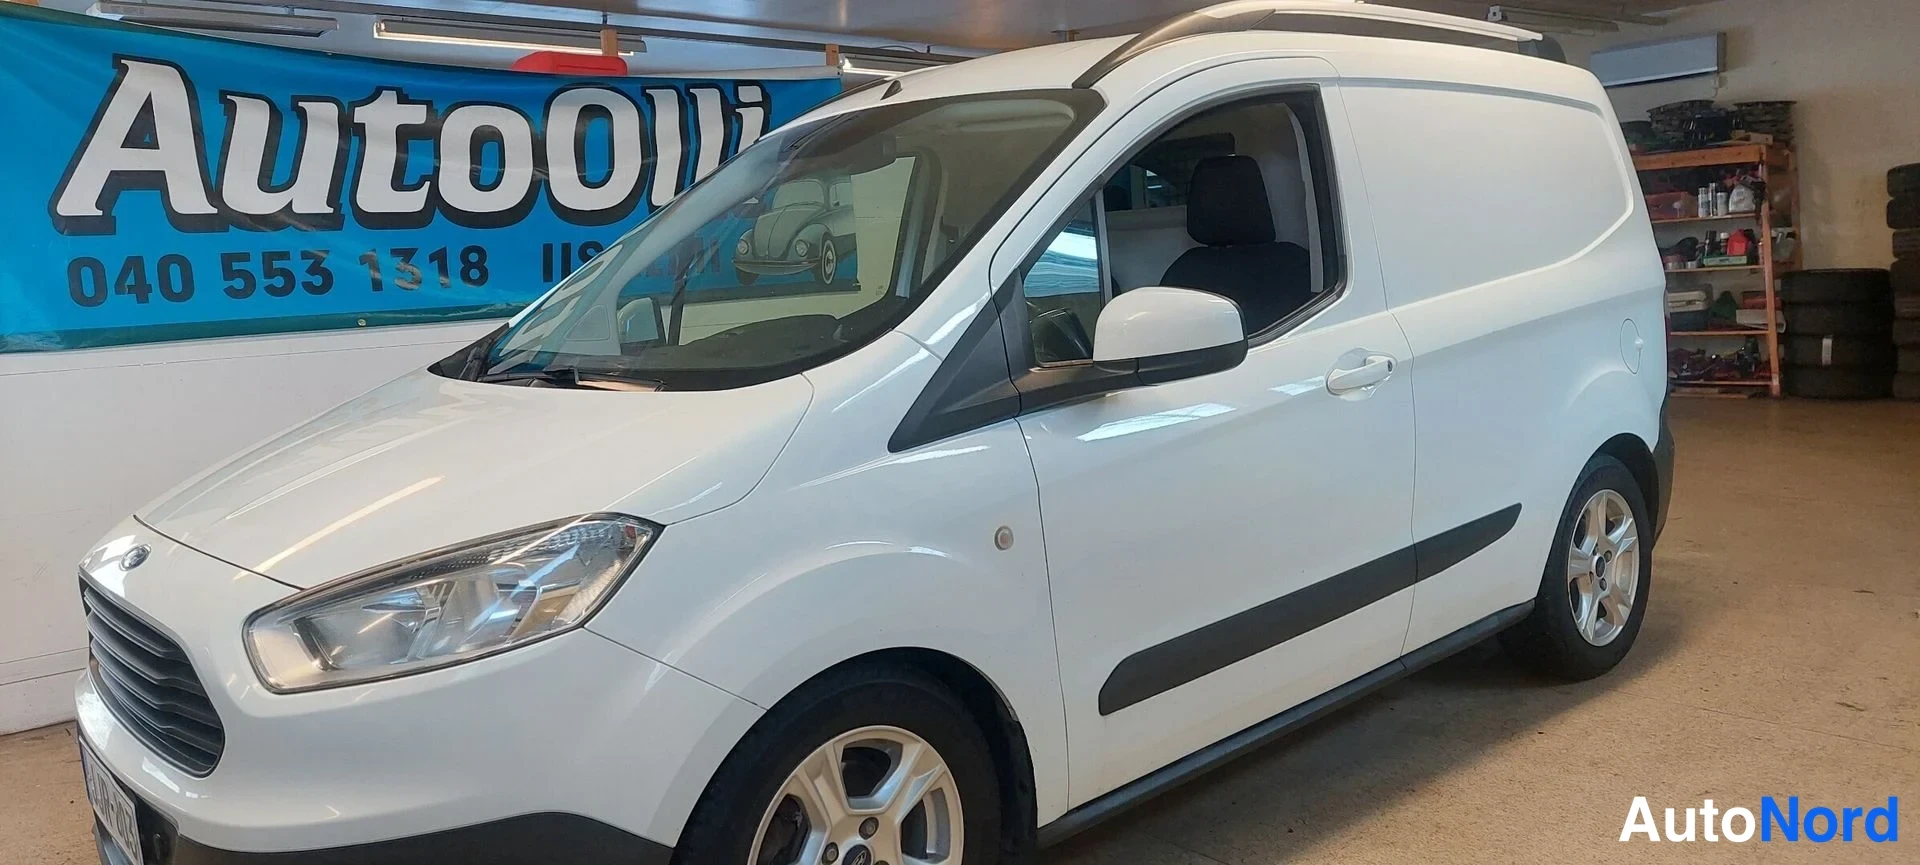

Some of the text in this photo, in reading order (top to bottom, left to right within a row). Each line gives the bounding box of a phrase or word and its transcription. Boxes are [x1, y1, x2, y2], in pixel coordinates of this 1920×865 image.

[50, 55, 769, 233] AutoOlli
[67, 253, 195, 307] 040
[220, 250, 334, 299] 553
[359, 245, 489, 293] 1318
